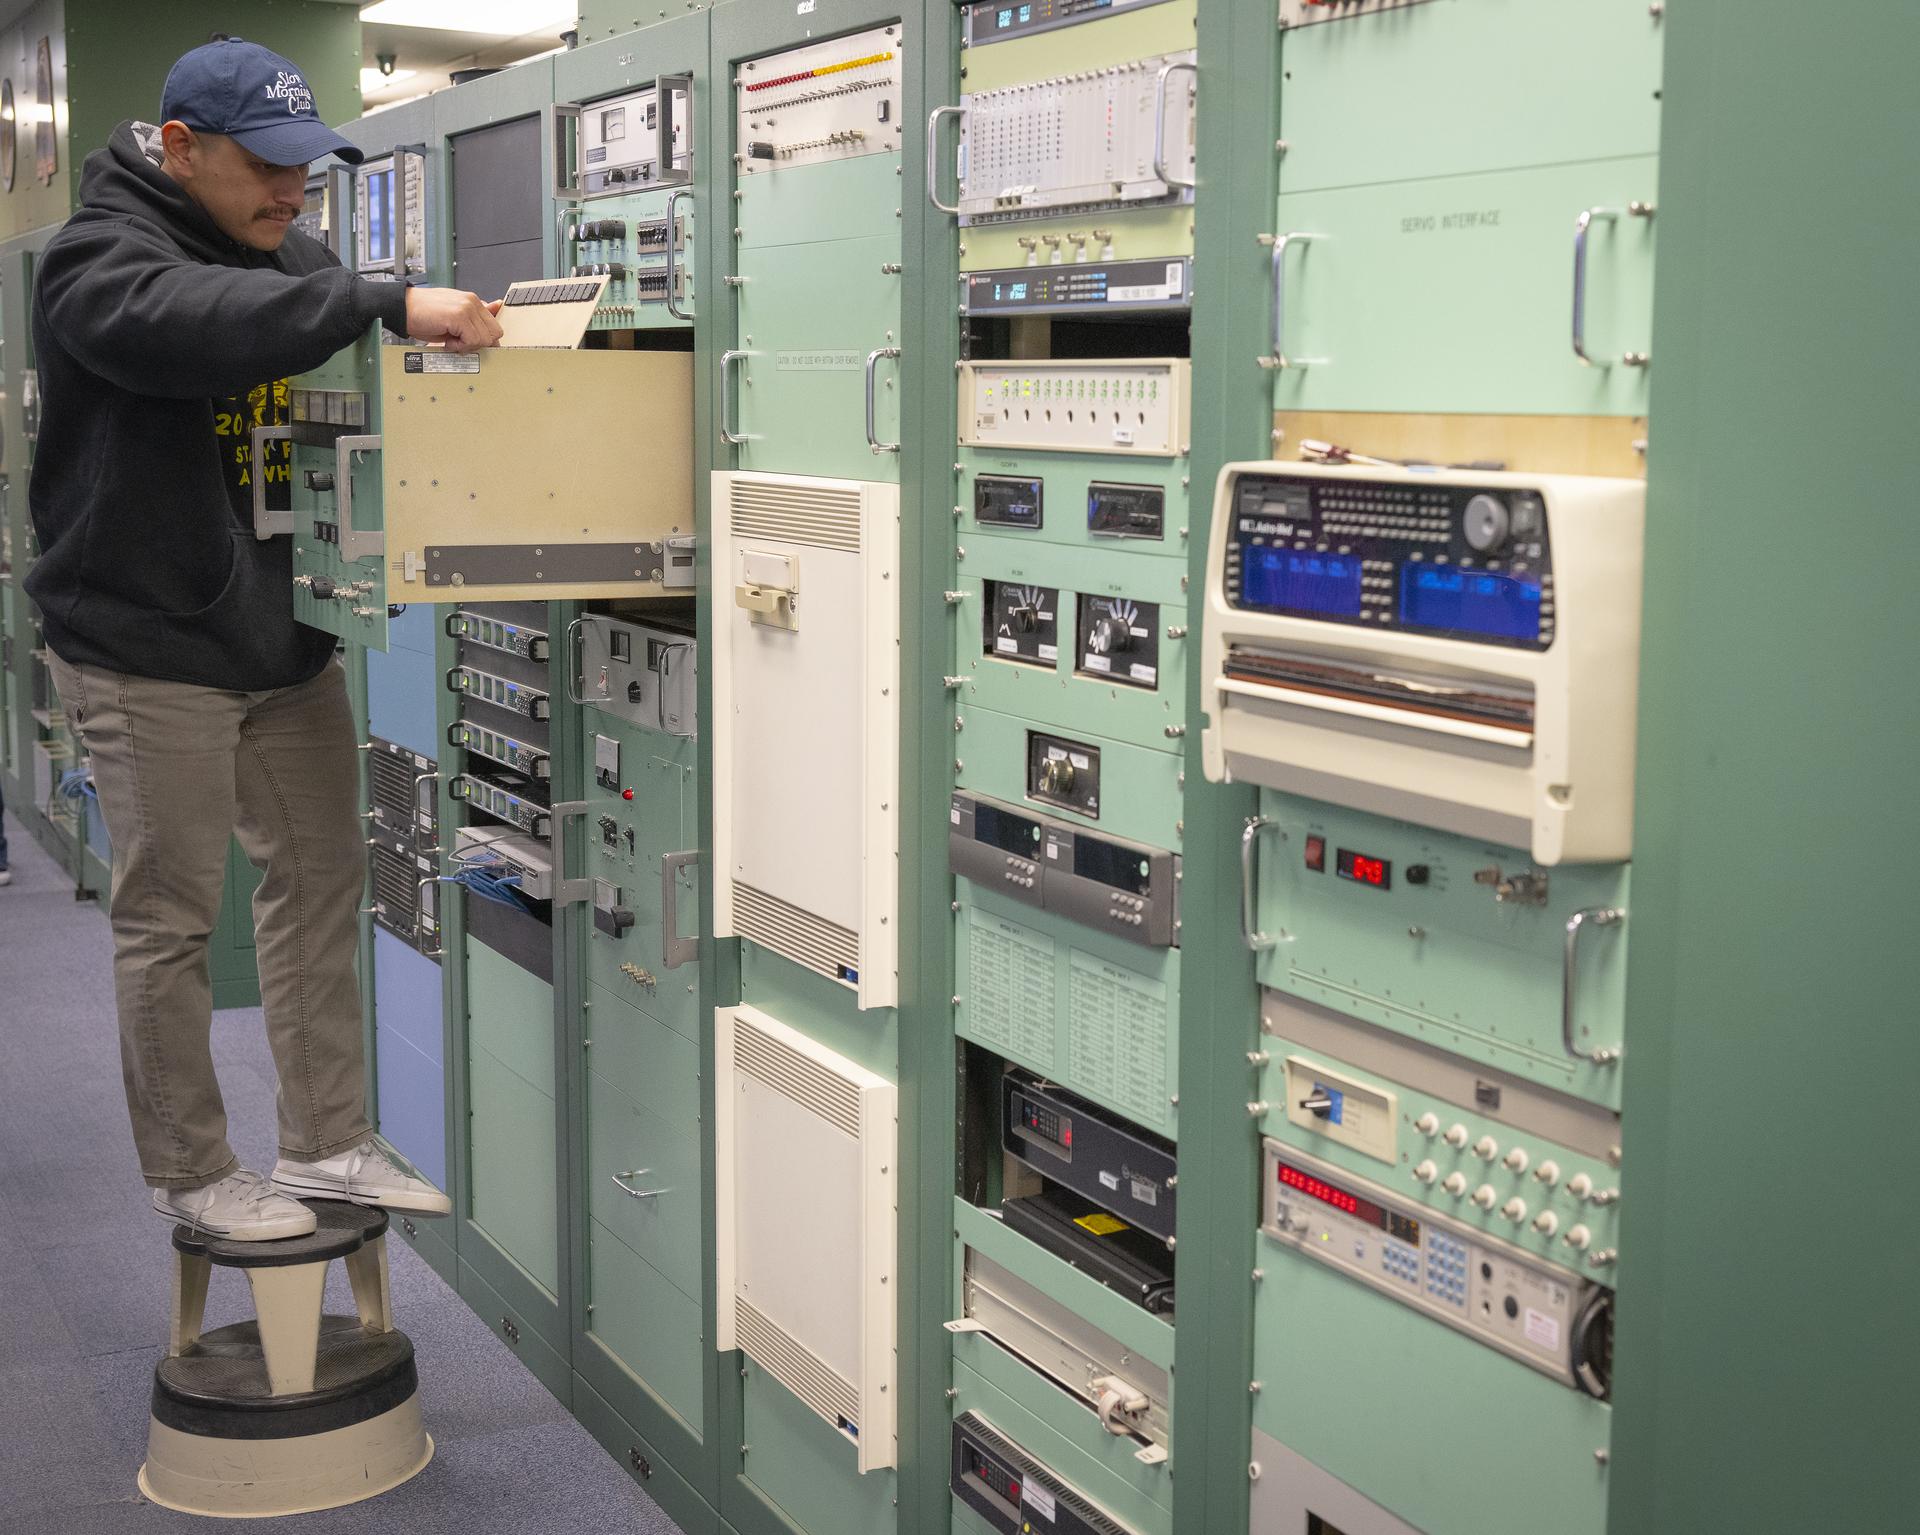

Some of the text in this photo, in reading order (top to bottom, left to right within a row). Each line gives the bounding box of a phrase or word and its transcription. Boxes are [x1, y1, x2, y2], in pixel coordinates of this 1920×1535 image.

[288, 96, 311, 114] Club
[1402, 215, 1436, 233] SERVO
[236, 442, 272, 464] STY
